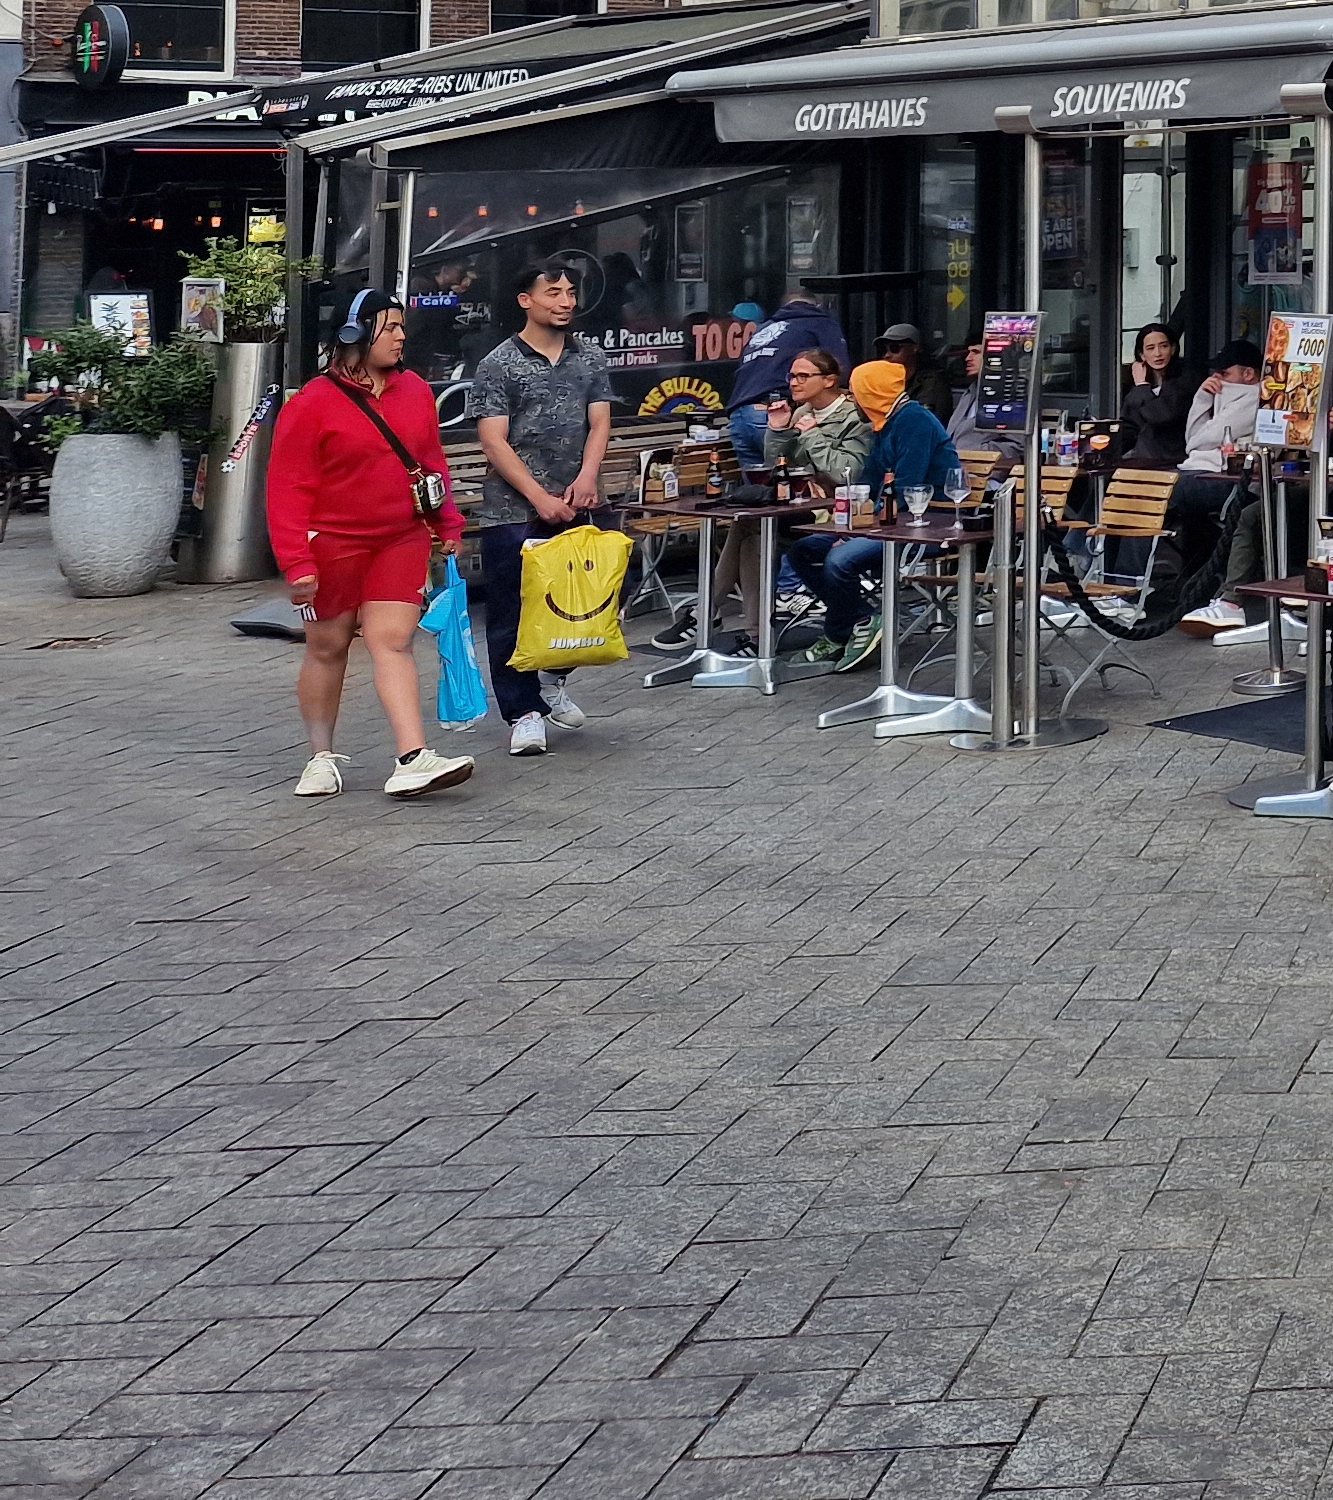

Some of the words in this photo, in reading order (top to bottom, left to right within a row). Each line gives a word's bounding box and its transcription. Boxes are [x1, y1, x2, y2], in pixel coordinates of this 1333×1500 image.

[325, 79, 380, 101] FAMOUS
[376, 74, 453, 96] SPARE-RIBS
[454, 68, 530, 92] UNLIMITED
[1050, 78, 1191, 119] SOUVENIRS
[794, 95, 928, 133] GOTTAHAVES
[1053, 217, 1073, 232] ARE
[421, 297, 452, 306] Café
[572, 331, 600, 345] ffee
[604, 330, 615, 348] &
[619, 327, 684, 348] Pancakes
[692, 323, 722, 362] TO
[1297, 337, 1325, 357] FOOD
[606, 353, 625, 367] and
[627, 352, 658, 366] Drinks
[638, 385, 665, 416] THE
[548, 636, 606, 650] JUMBO
